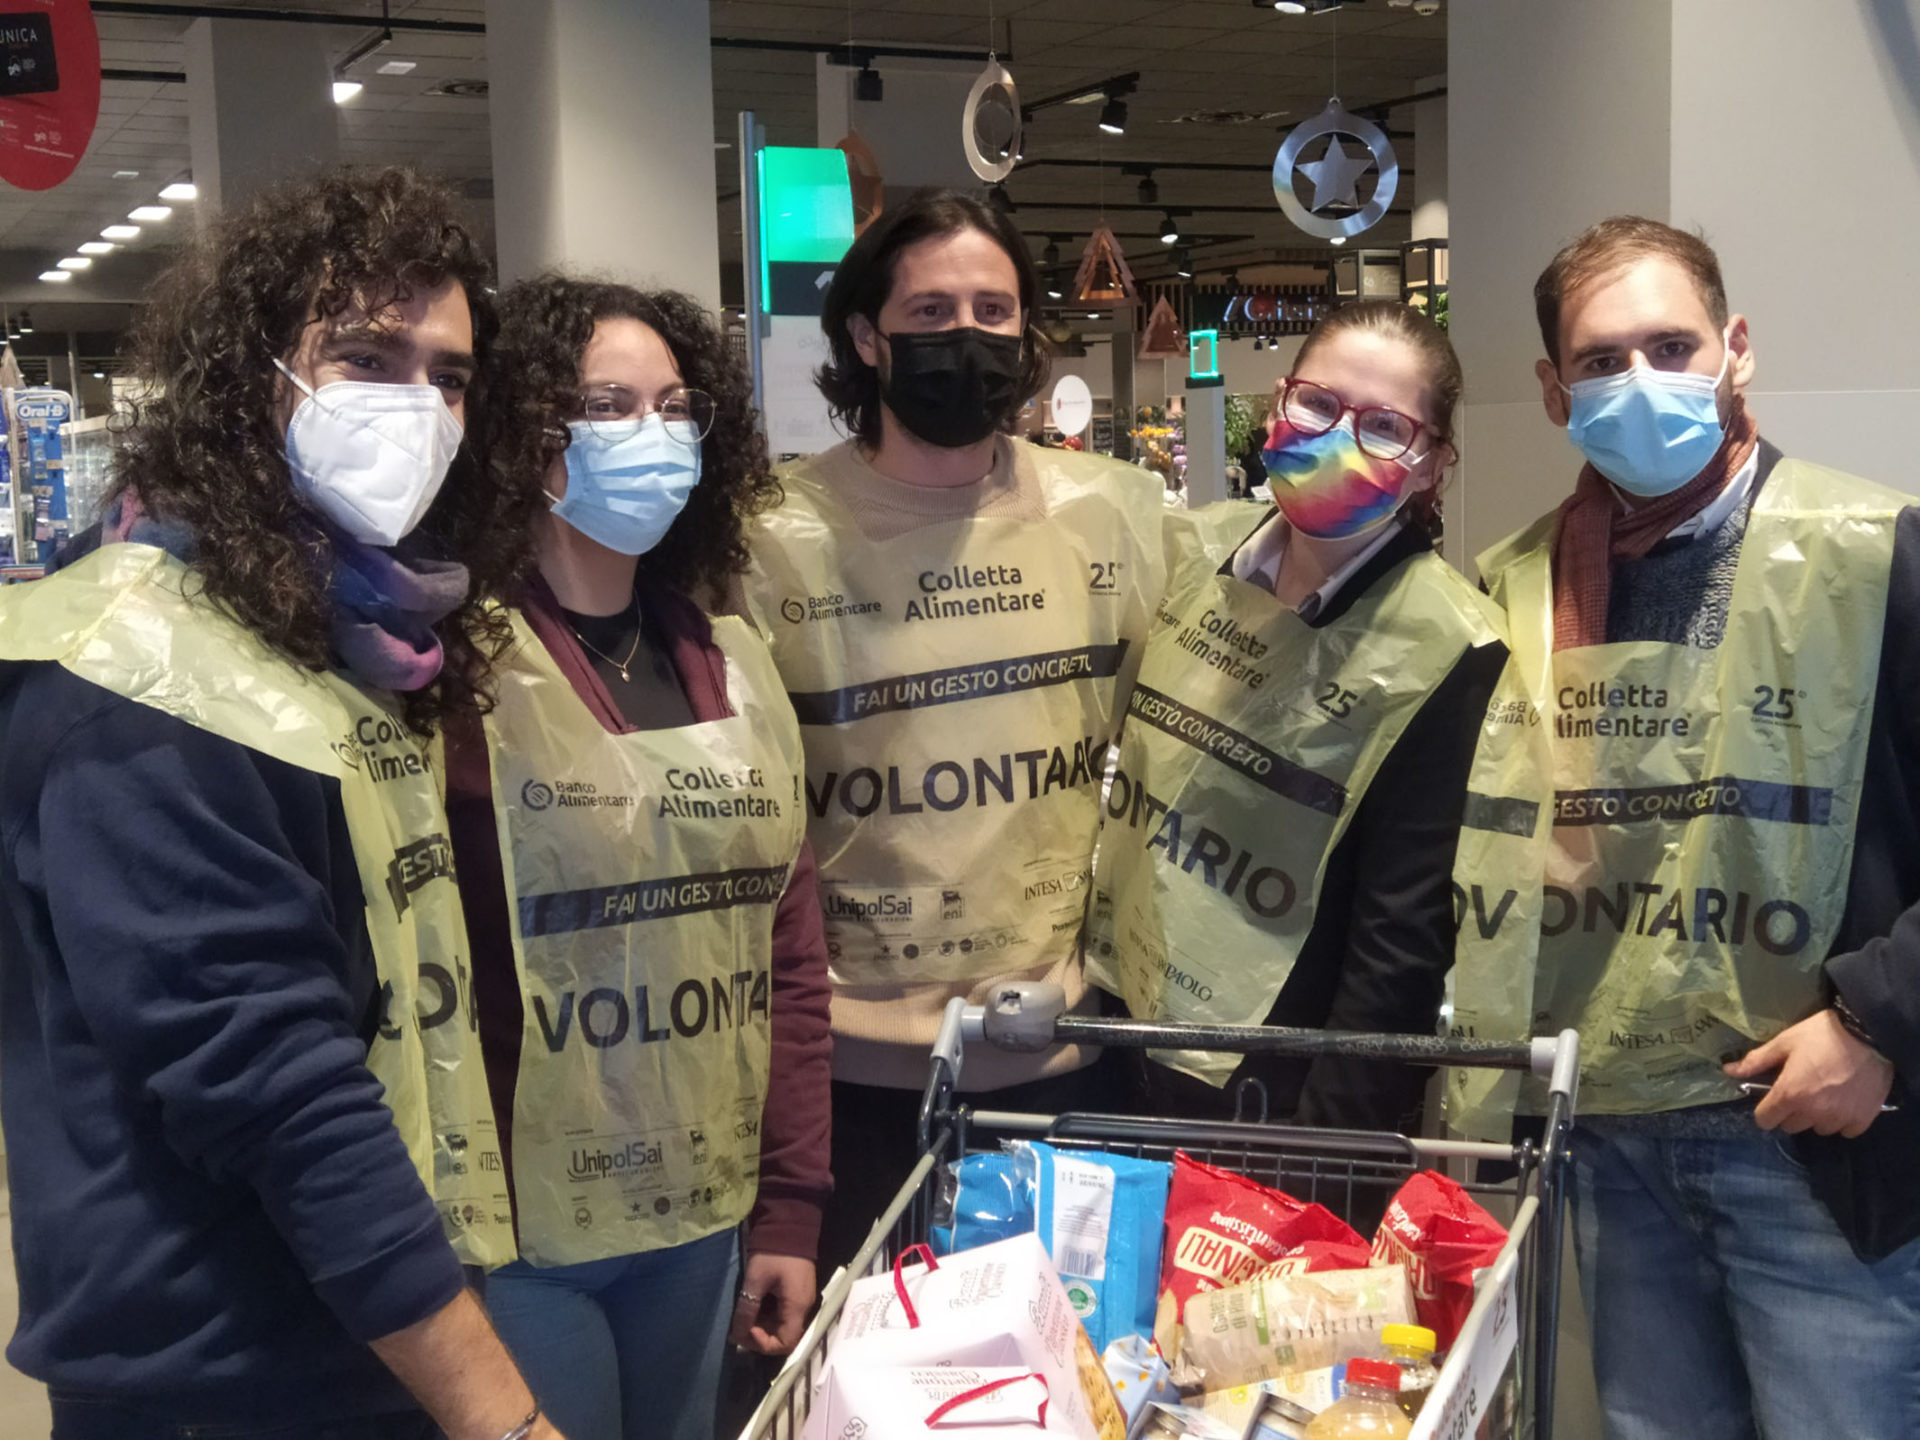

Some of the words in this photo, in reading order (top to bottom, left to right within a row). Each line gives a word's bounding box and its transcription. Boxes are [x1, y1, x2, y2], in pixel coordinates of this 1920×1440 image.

[19, 403, 66, 418] Oral-B
[918, 565, 1022, 592] Colletta
[808, 594, 844, 610] Banco
[808, 601, 881, 623] Alimentare
[1200, 609, 1268, 661] Colletta
[853, 687, 890, 712] FAI
[895, 682, 926, 704] UN
[930, 668, 998, 699] GESTO
[1558, 683, 1668, 709] Colletta
[1141, 697, 1182, 726] GESTO
[1179, 716, 1272, 775] CONCRETO
[555, 780, 596, 794] Banco
[604, 892, 636, 918] FAI
[642, 886, 676, 913] UN
[681, 877, 733, 907] GESTO
[1025, 879, 1063, 900] INTESA
[828, 895, 912, 920] UnipolSai
[943, 910, 962, 920] eni
[1164, 963, 1213, 1002] PAOLO
[571, 1141, 664, 1178] UnipolSai
